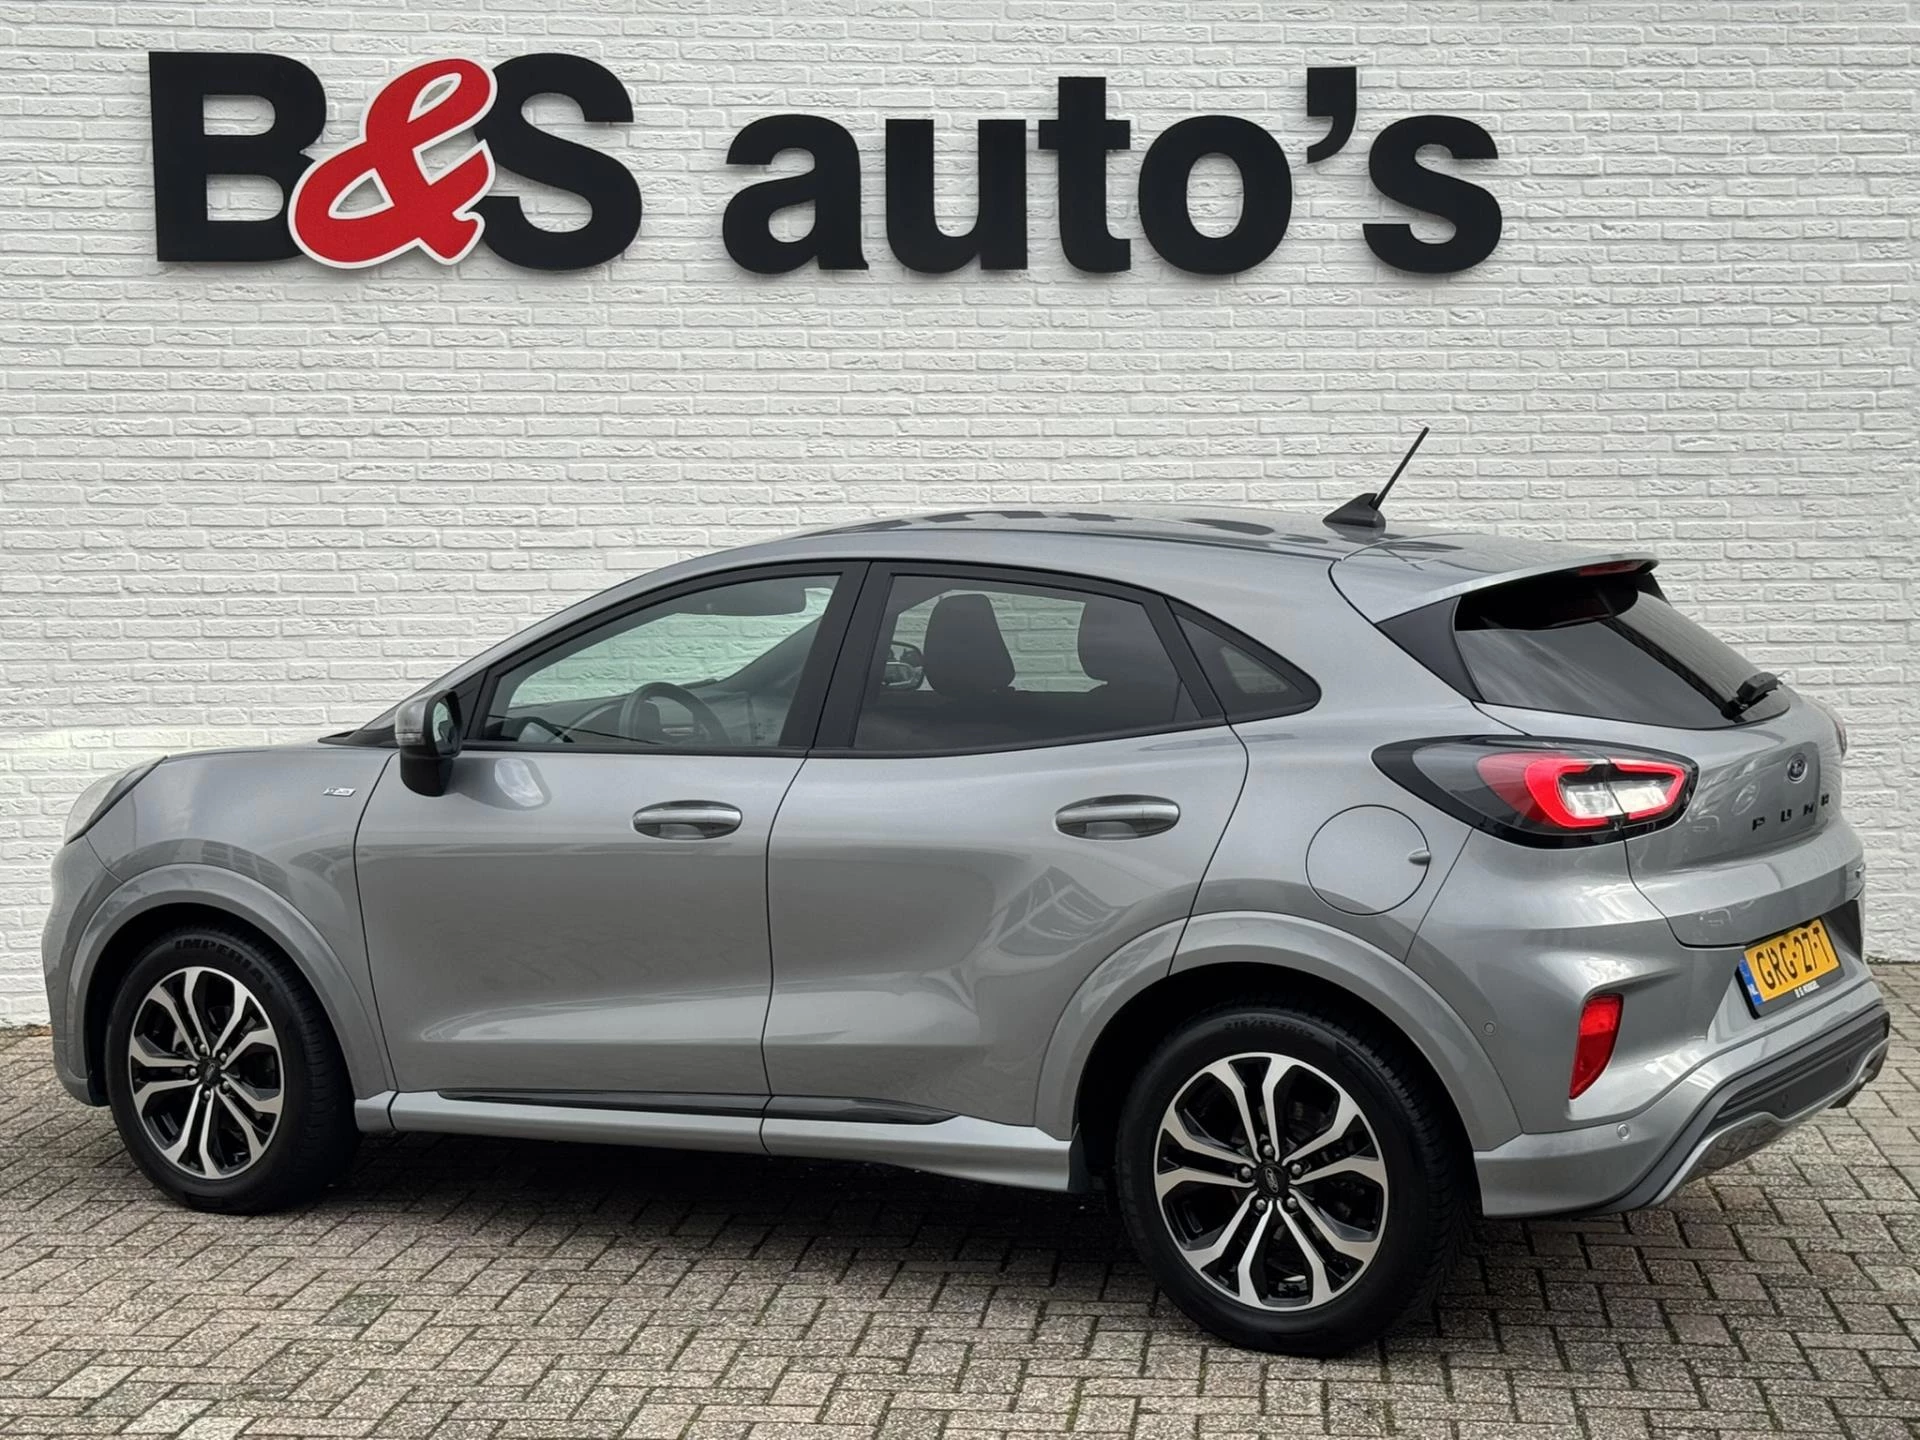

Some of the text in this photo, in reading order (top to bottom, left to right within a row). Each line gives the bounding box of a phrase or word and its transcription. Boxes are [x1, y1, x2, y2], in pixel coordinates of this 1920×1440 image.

[149, 52, 1503, 275] B&S auto's
[1755, 926, 1830, 990] GRG-27-T
